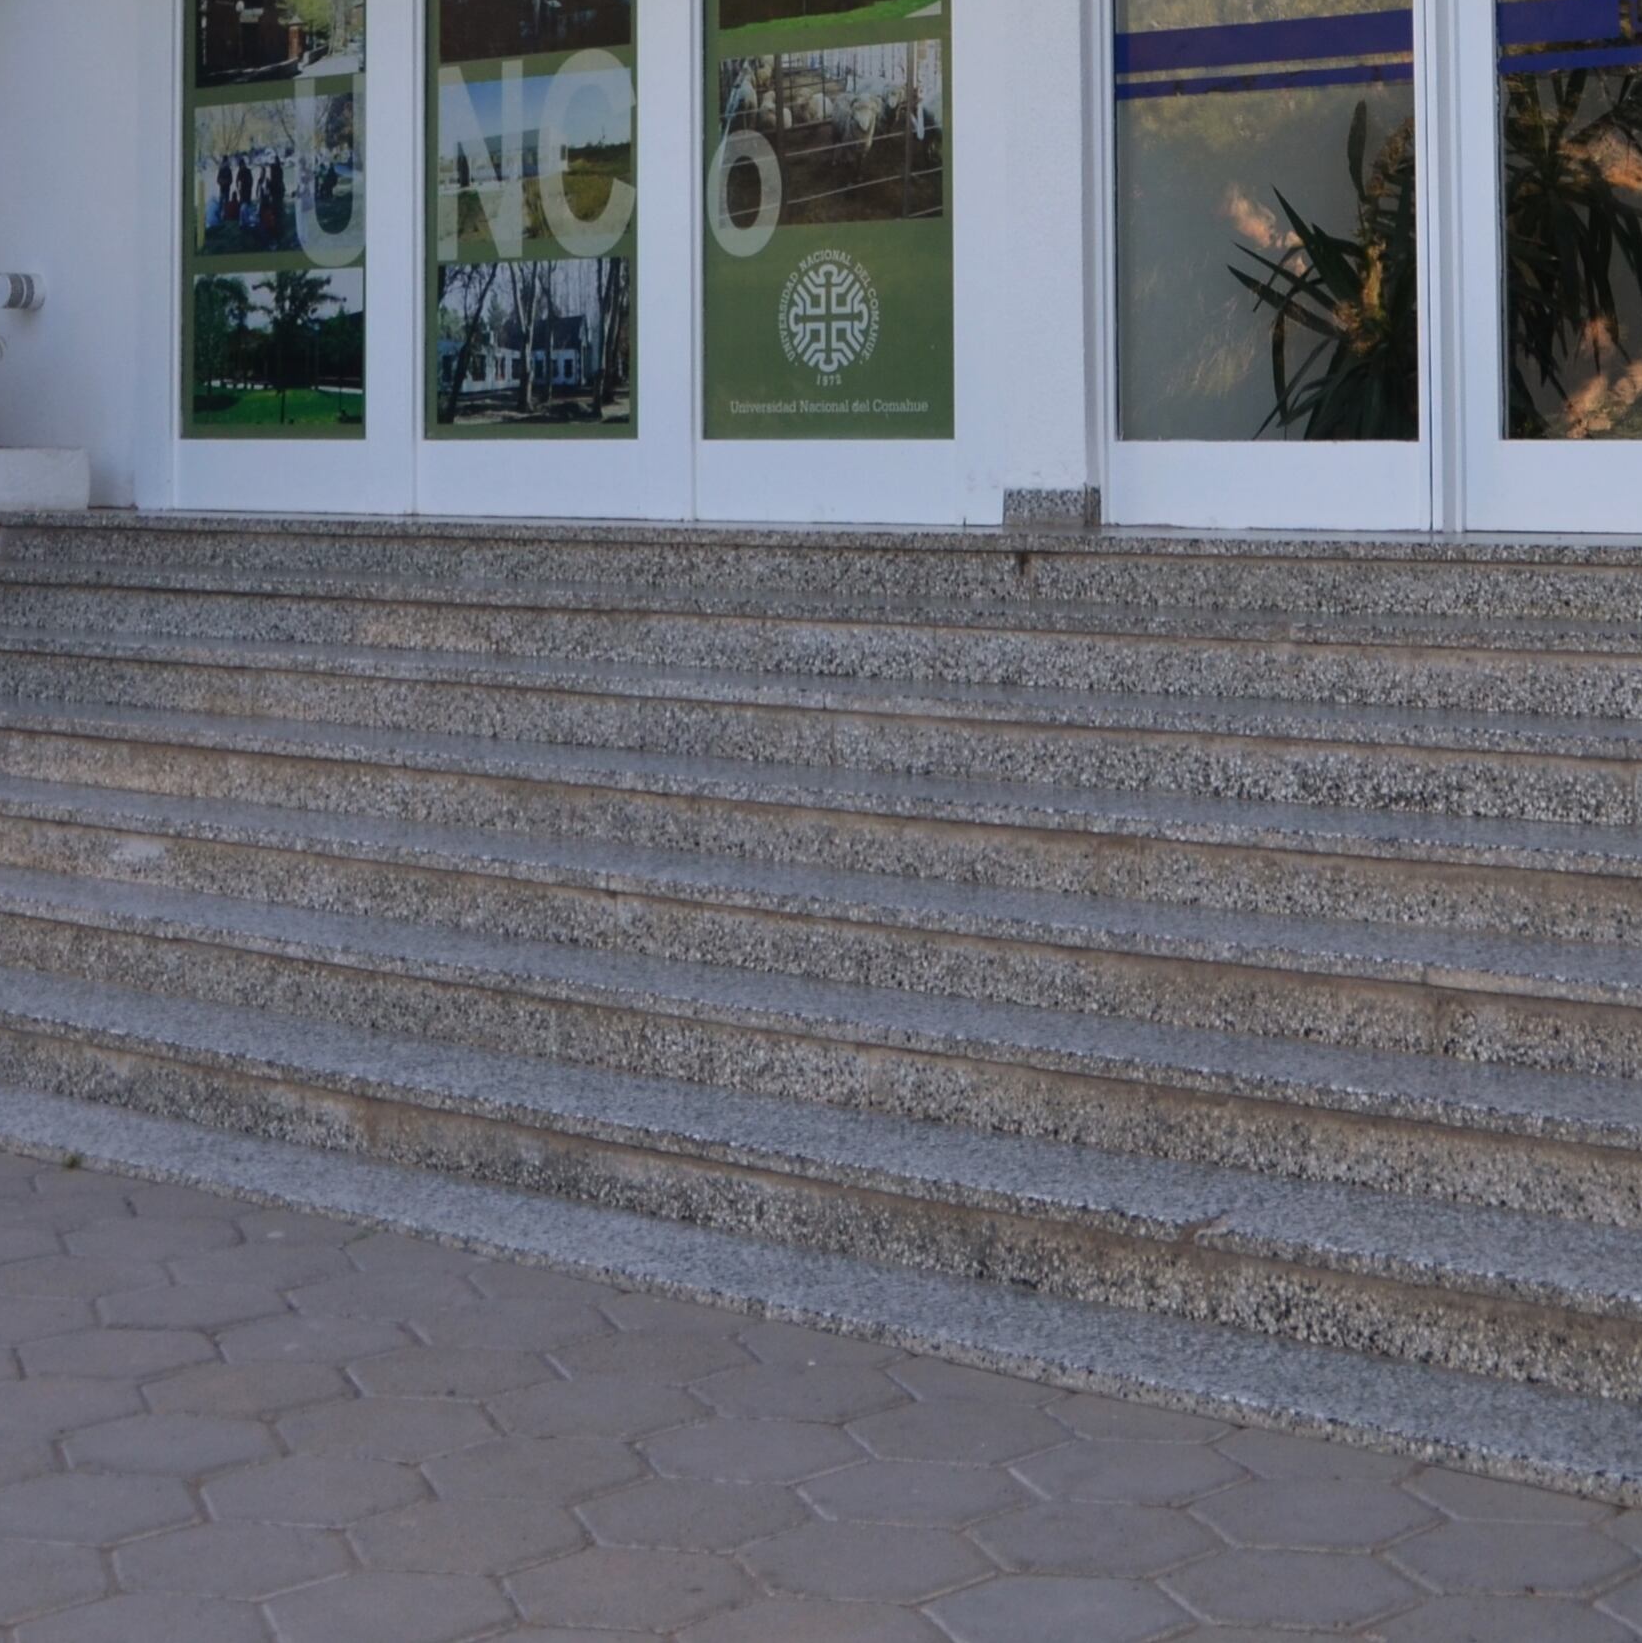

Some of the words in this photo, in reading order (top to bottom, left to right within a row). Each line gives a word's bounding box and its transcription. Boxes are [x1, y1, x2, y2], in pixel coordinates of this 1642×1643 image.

[799, 249, 852, 272] NACIONAL
[854, 262, 872, 288] DEL
[778, 271, 799, 362] UNIVERSIDAD
[861, 288, 880, 361] COMAHUE
[730, 400, 797, 415] Universidad
[799, 399, 850, 414] Nacional
[851, 399, 870, 413] del
[872, 398, 929, 414] Comahue
